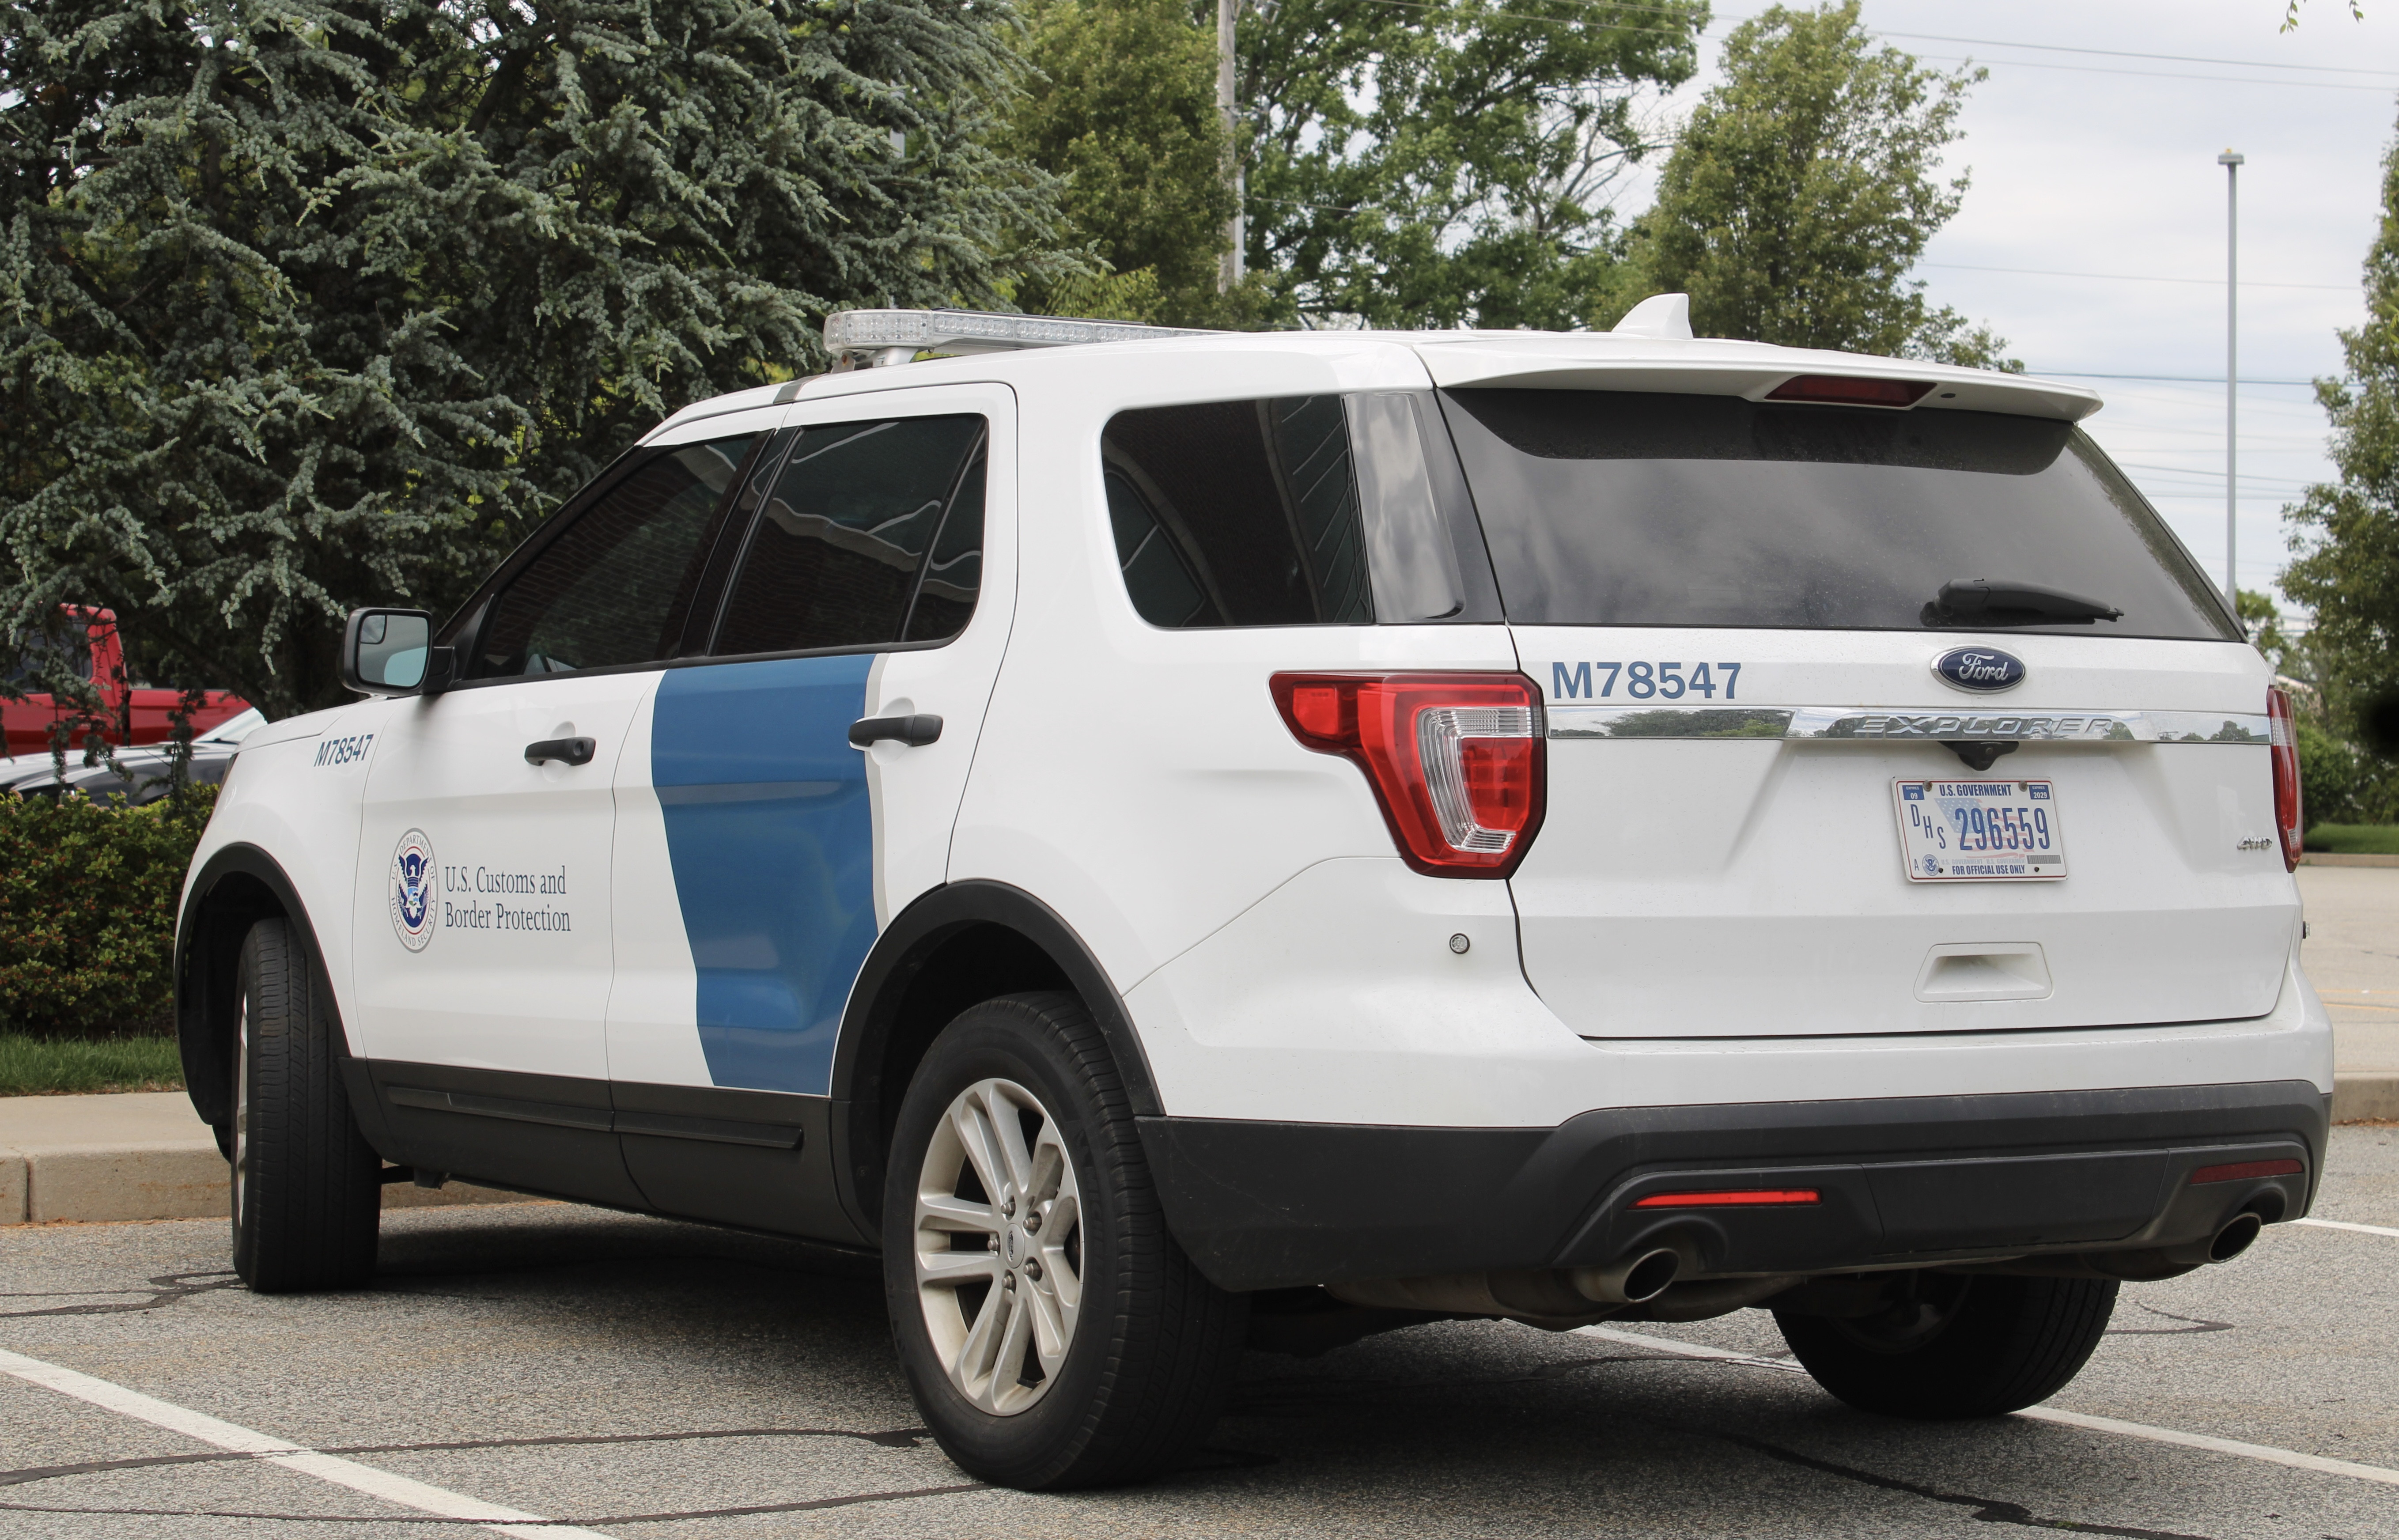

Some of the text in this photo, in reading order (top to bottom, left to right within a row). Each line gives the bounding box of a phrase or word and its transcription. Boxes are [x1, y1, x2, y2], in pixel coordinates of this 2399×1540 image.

[1552, 661, 1741, 699] M78547
[1959, 653, 2009, 681] Ford
[1852, 716, 2113, 735] EXPLORER
[313, 733, 375, 767] M78547
[1939, 784, 2011, 796] U.S. GOVERNMENT
[1955, 808, 2050, 850] 296559
[399, 834, 432, 863] DEPARTMENT
[429, 867, 435, 882] OF
[1914, 859, 1920, 871] A
[1952, 864, 2025, 875] FOR OFFICIAL USE ONLY
[445, 865, 567, 894] U.S. Customs and
[391, 897, 435, 946] HOMELAND SECURITY
[445, 900, 571, 931] Border Protection
